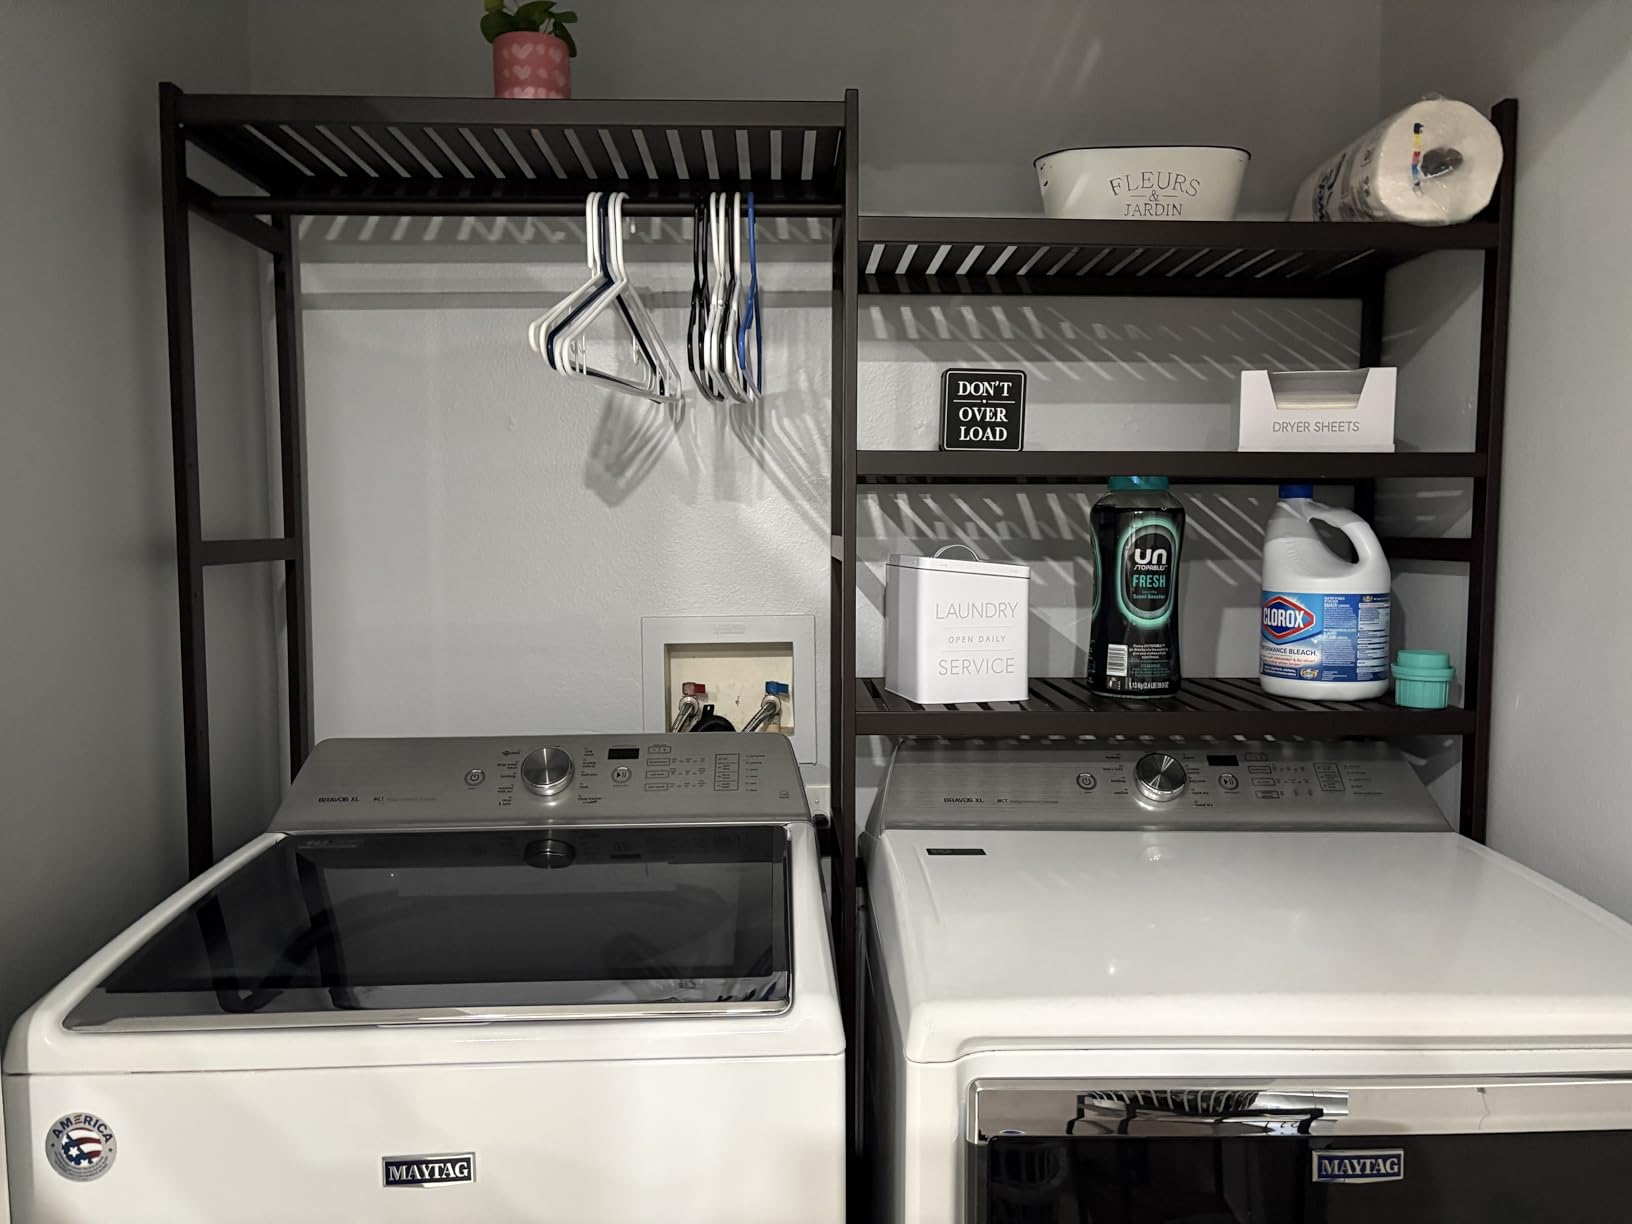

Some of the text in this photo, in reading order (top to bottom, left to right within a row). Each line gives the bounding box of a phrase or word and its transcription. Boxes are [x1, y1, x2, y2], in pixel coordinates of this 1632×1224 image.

[1109, 171, 1200, 197] FLEURS
[1149, 189, 1160, 202] &
[1124, 203, 1182, 217] JARDIN
[957, 380, 1012, 397] DON'T
[958, 406, 1009, 422] OVER
[958, 426, 1008, 442] LOAD
[1272, 420, 1361, 433] DRYER SHEETS
[1132, 574, 1166, 588] FRESH
[935, 601, 1019, 620] LAUNDRY
[1262, 606, 1305, 628] CLOROX
[947, 634, 1006, 644] OPEN DAILY
[937, 657, 1016, 676] SERVICE
[52, 1113, 114, 1144] AMERICA
[387, 1161, 470, 1181] MAYTAG
[1319, 1157, 1400, 1176] MAYTAG
